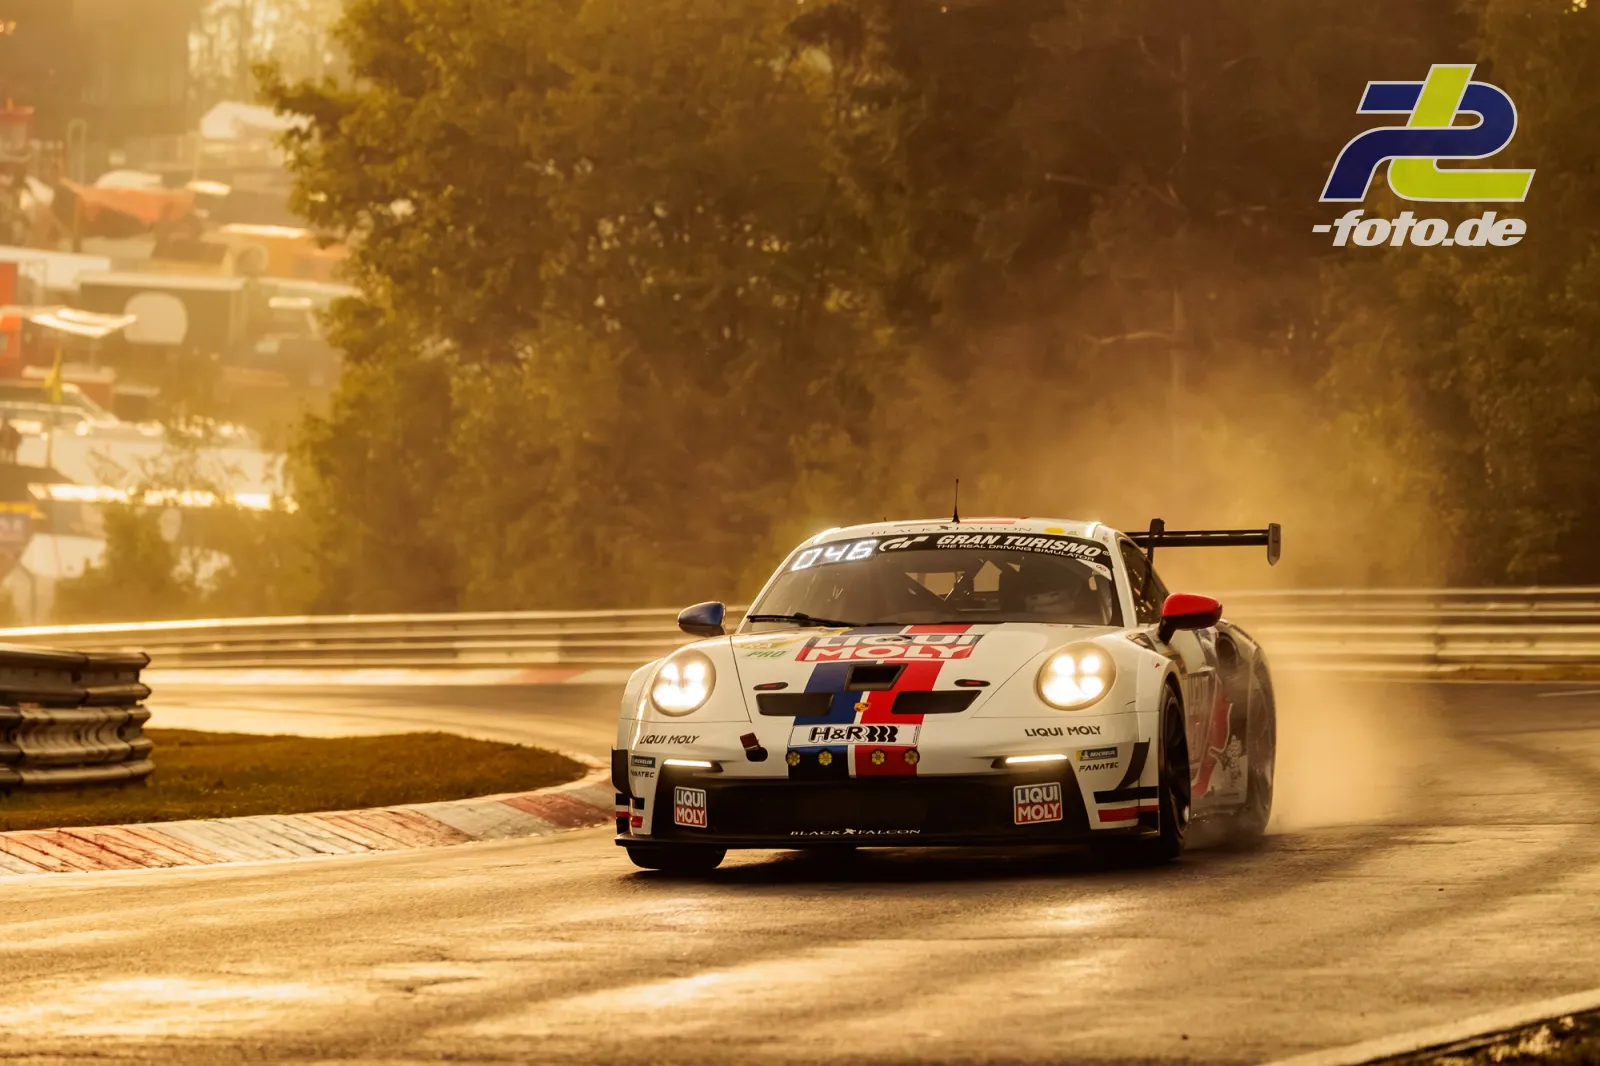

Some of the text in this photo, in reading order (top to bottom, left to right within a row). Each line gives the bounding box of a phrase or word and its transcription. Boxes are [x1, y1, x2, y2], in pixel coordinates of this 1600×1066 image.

[936, 534, 1102, 557] GRAN TURISMO
[988, 544, 1032, 552] DRIVING
[1033, 547, 1095, 562] SIMULATOR
[791, 539, 878, 571] 046
[812, 635, 979, 647] LIQUI
[804, 645, 973, 661] MOLY
[639, 734, 700, 745] LIQUI MOLY
[1024, 725, 1102, 737] LIQUI MOLY
[1078, 761, 1120, 773] FANATEC
[675, 789, 704, 808] LIQUI
[1017, 785, 1059, 804] LIQUI
[676, 807, 705, 825] MOLY
[1017, 802, 1060, 822] MOLY
